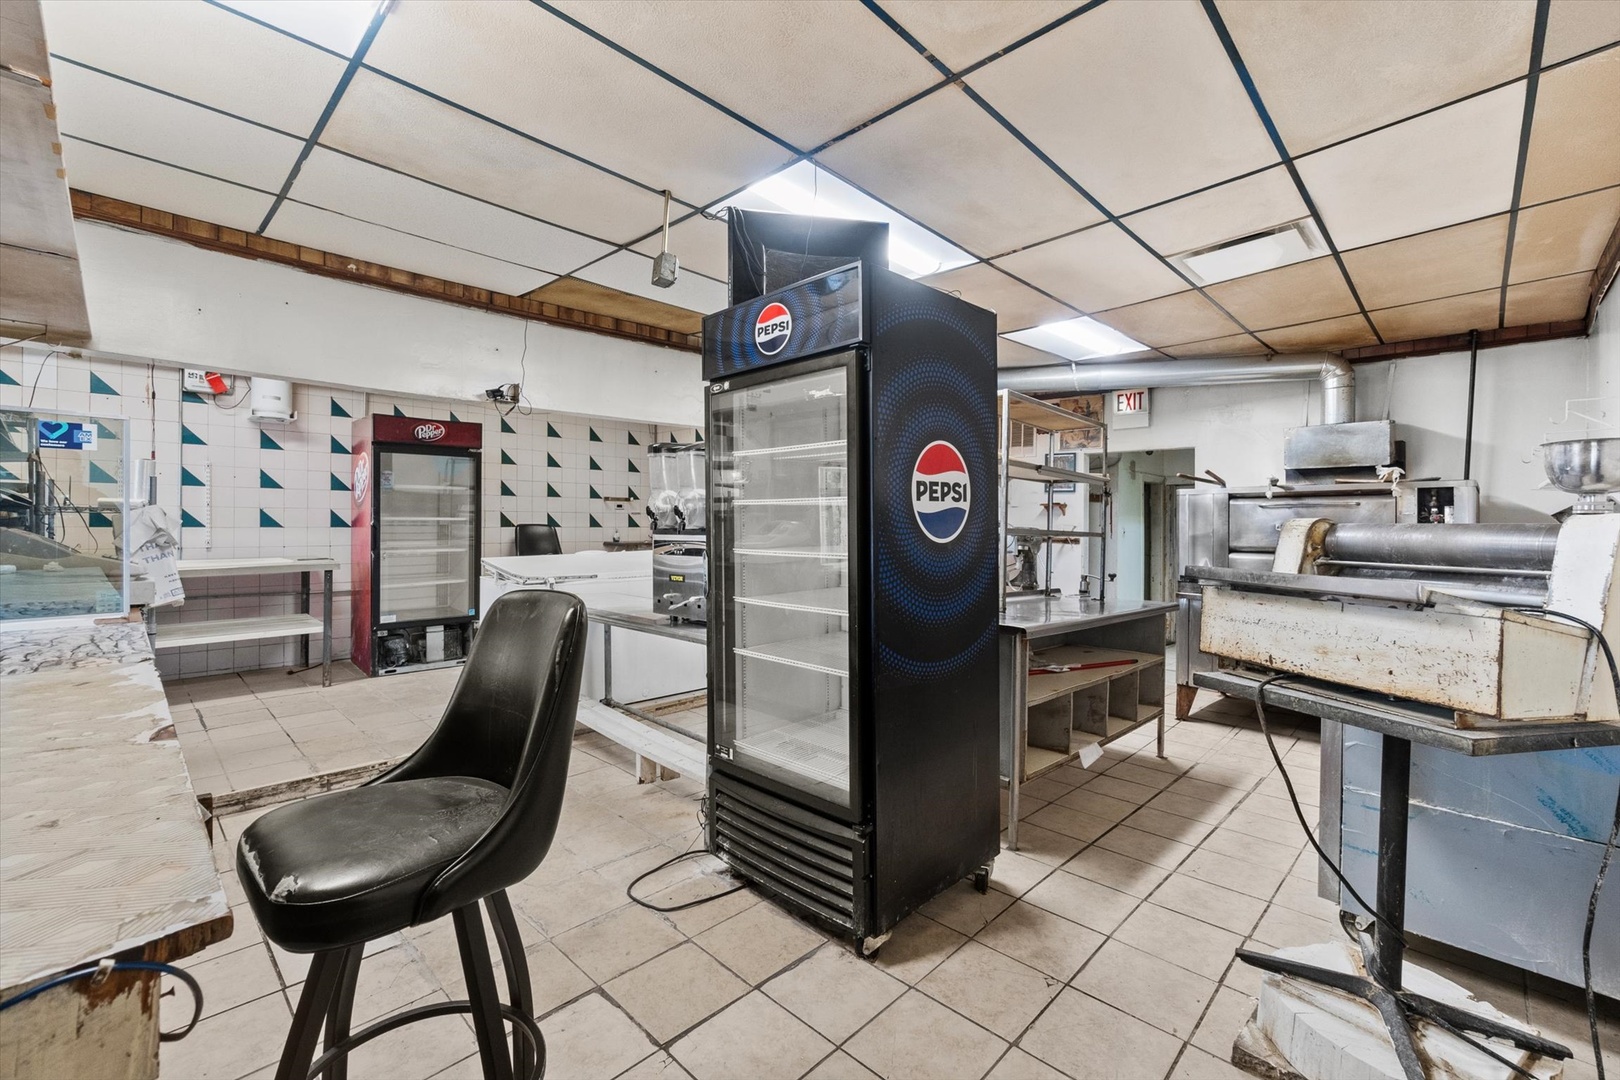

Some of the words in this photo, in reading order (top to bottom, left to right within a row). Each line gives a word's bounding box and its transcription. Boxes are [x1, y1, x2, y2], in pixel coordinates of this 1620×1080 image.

[756, 320, 790, 338] PEPSI
[1117, 391, 1144, 412] EXIT
[416, 425, 443, 439] Pepper
[425, 424, 437, 432] Dr
[916, 480, 968, 503] PEPSI
[142, 550, 174, 564] THAN
